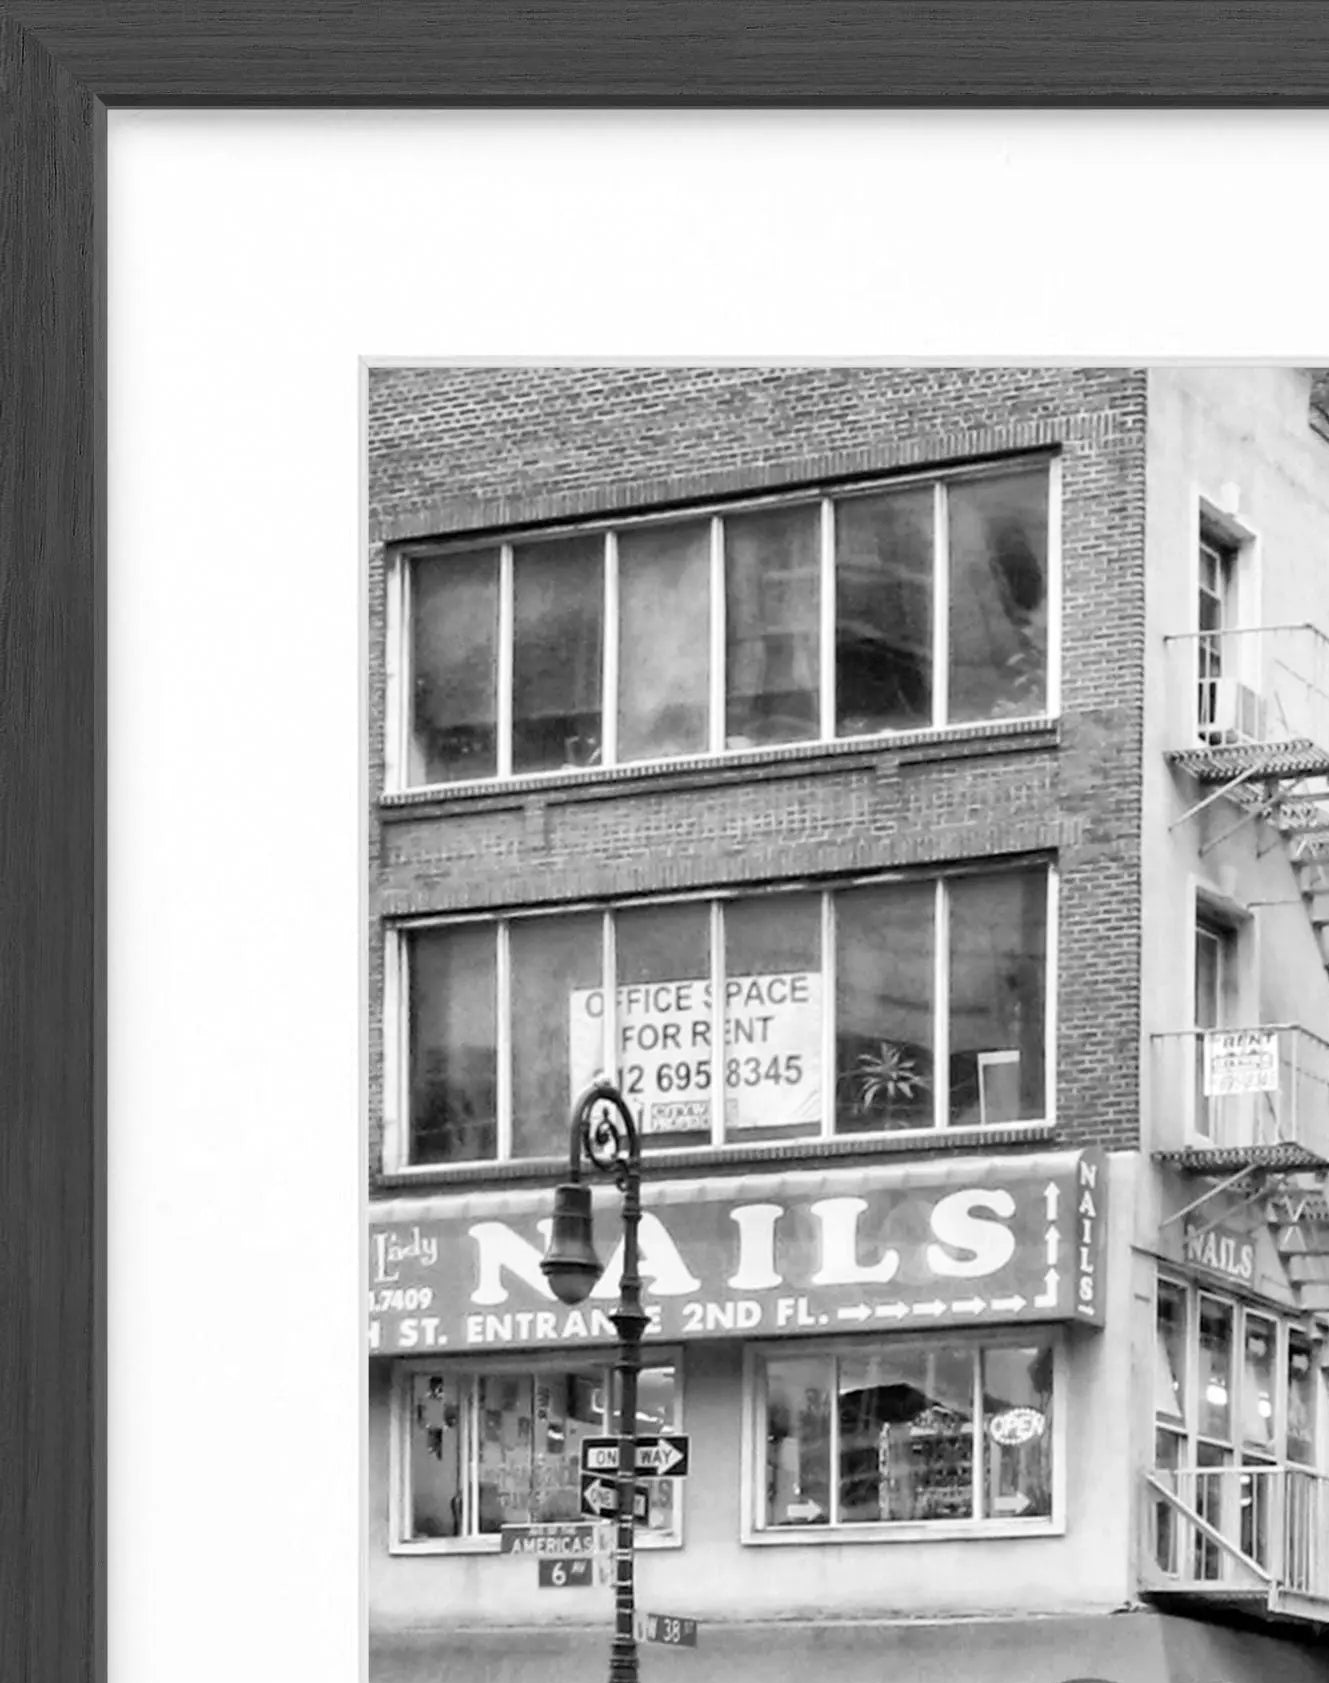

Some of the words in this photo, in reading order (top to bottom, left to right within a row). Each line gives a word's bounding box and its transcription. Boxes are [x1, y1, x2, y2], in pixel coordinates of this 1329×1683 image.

[584, 984, 693, 1018] OFICE
[621, 1023, 681, 1052] FOR
[656, 1059, 712, 1093] 695
[725, 1054, 803, 1088] 8345
[468, 1188, 1017, 1307] NAILS
[1078, 1160, 1097, 1302] NAILS
[373, 1226, 438, 1283] Lady
[1186, 1223, 1253, 1279] NAILS
[399, 1316, 449, 1348] ST.
[465, 1304, 663, 1345] ENTRANE
[680, 1301, 764, 1334] 2ND
[775, 1296, 830, 1328] FL.
[992, 1411, 1045, 1439] OPEN
[641, 1448, 674, 1465] WAY
[510, 1536, 594, 1556] AMERICAS
[551, 1561, 567, 1587] 6
[663, 1618, 681, 1643] 38
